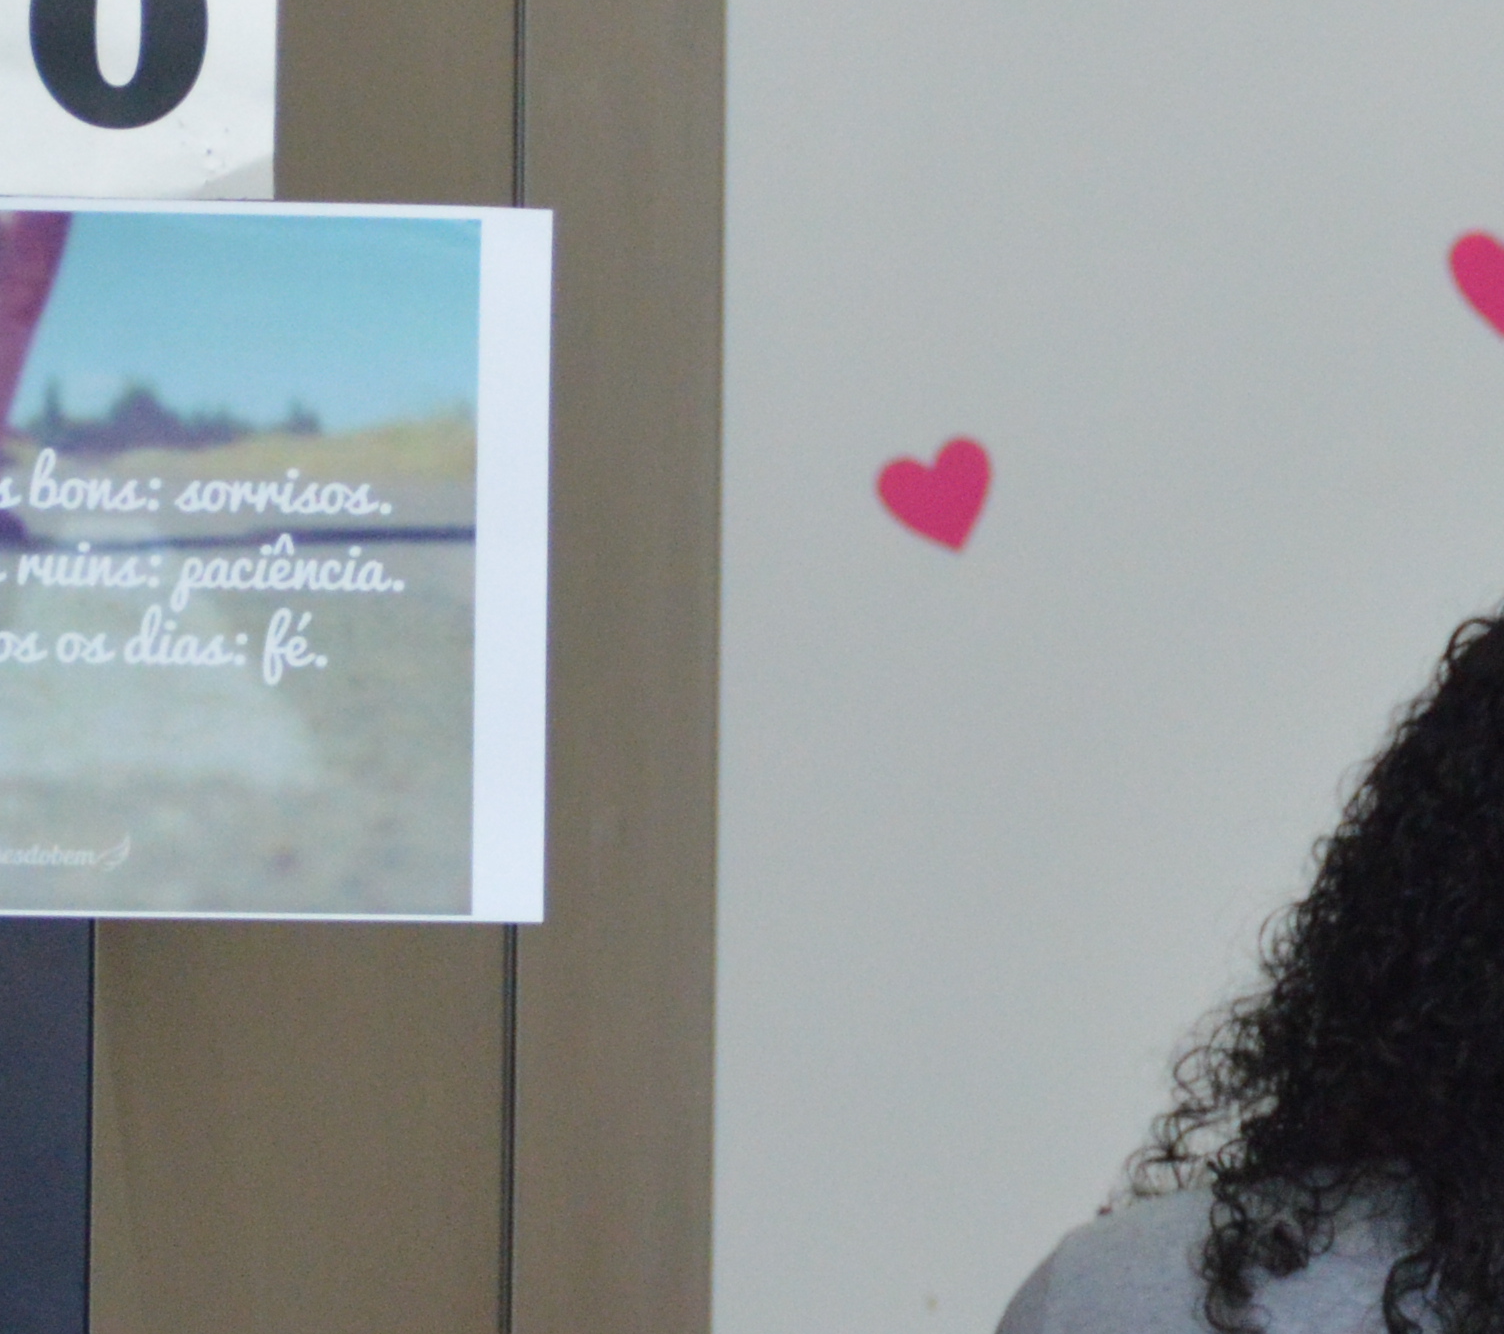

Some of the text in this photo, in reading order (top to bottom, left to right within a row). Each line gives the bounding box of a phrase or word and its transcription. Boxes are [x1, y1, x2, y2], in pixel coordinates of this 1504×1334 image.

[29, 447, 161, 511] bons:
[175, 468, 392, 515] sorrisos.
[17, 541, 161, 587] ruins:
[170, 533, 405, 612] paciência.
[56, 631, 116, 664] os
[124, 604, 248, 666] dias:
[263, 607, 328, 685] fé.
